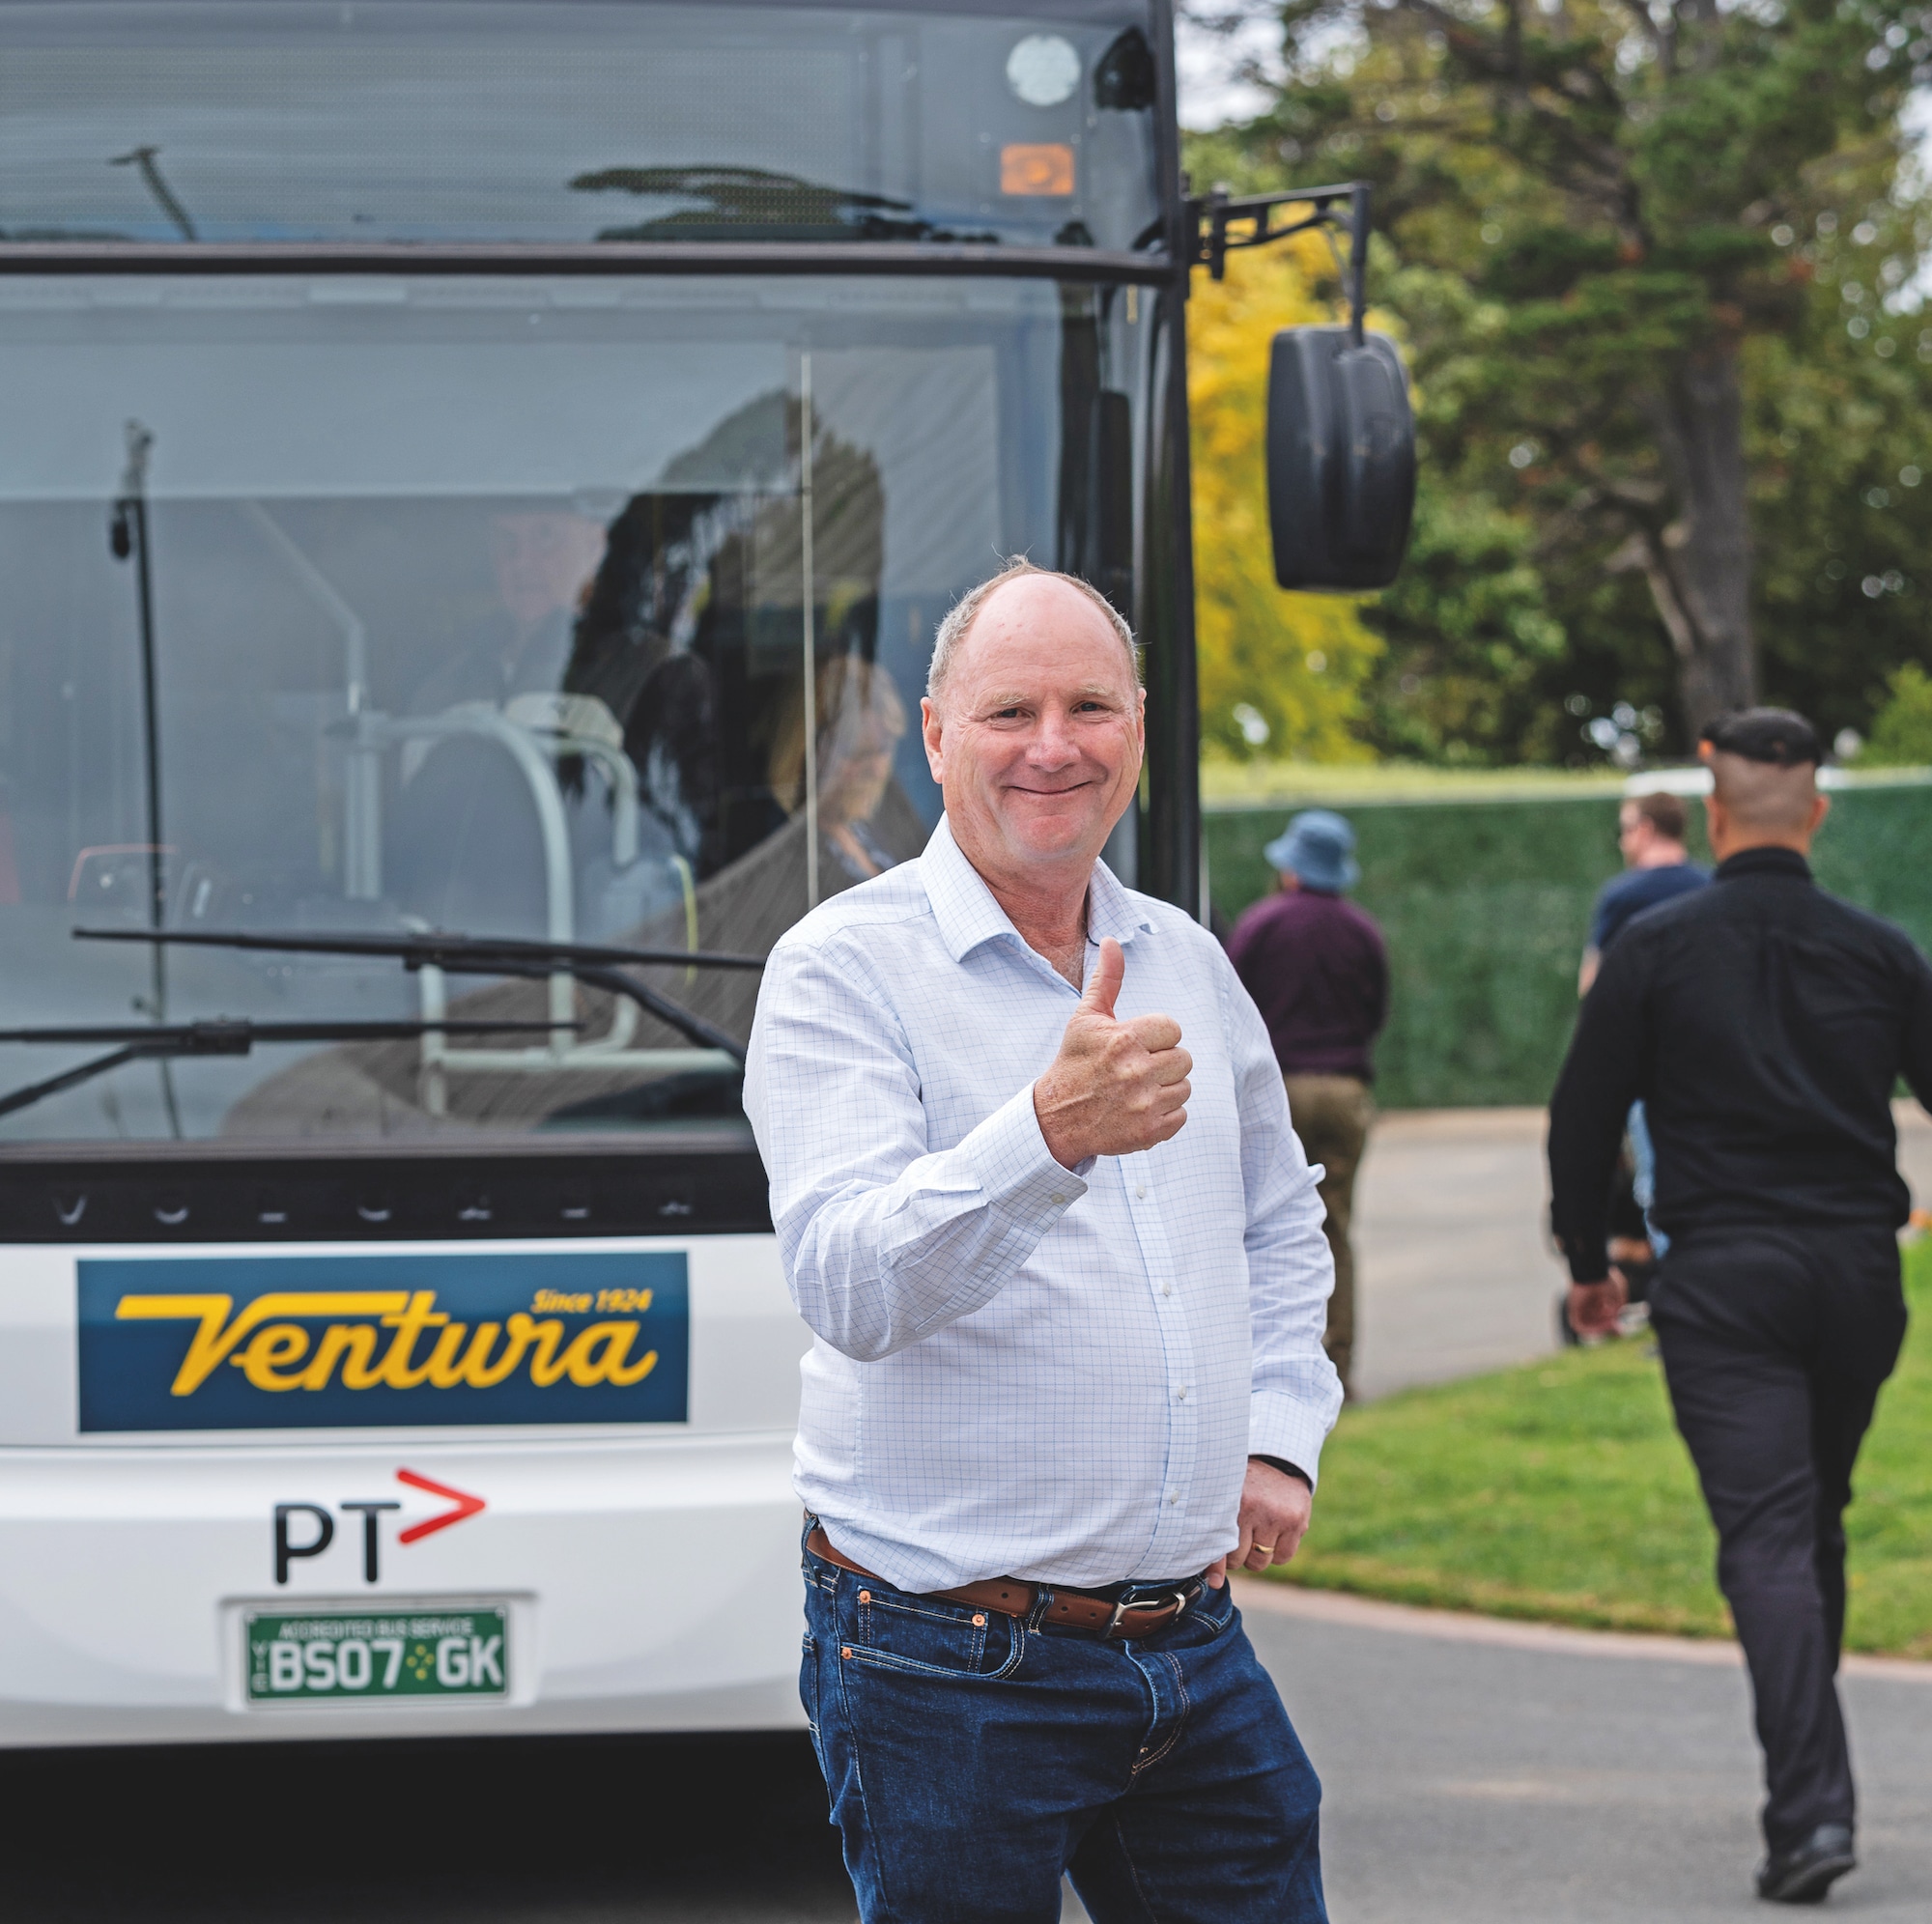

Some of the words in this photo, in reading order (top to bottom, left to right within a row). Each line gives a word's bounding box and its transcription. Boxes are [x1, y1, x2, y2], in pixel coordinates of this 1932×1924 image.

[530, 1288, 593, 1314] Since
[595, 1287, 653, 1313] 1924
[115, 1290, 658, 1396] Ventura
[435, 1635, 504, 1687] GK
